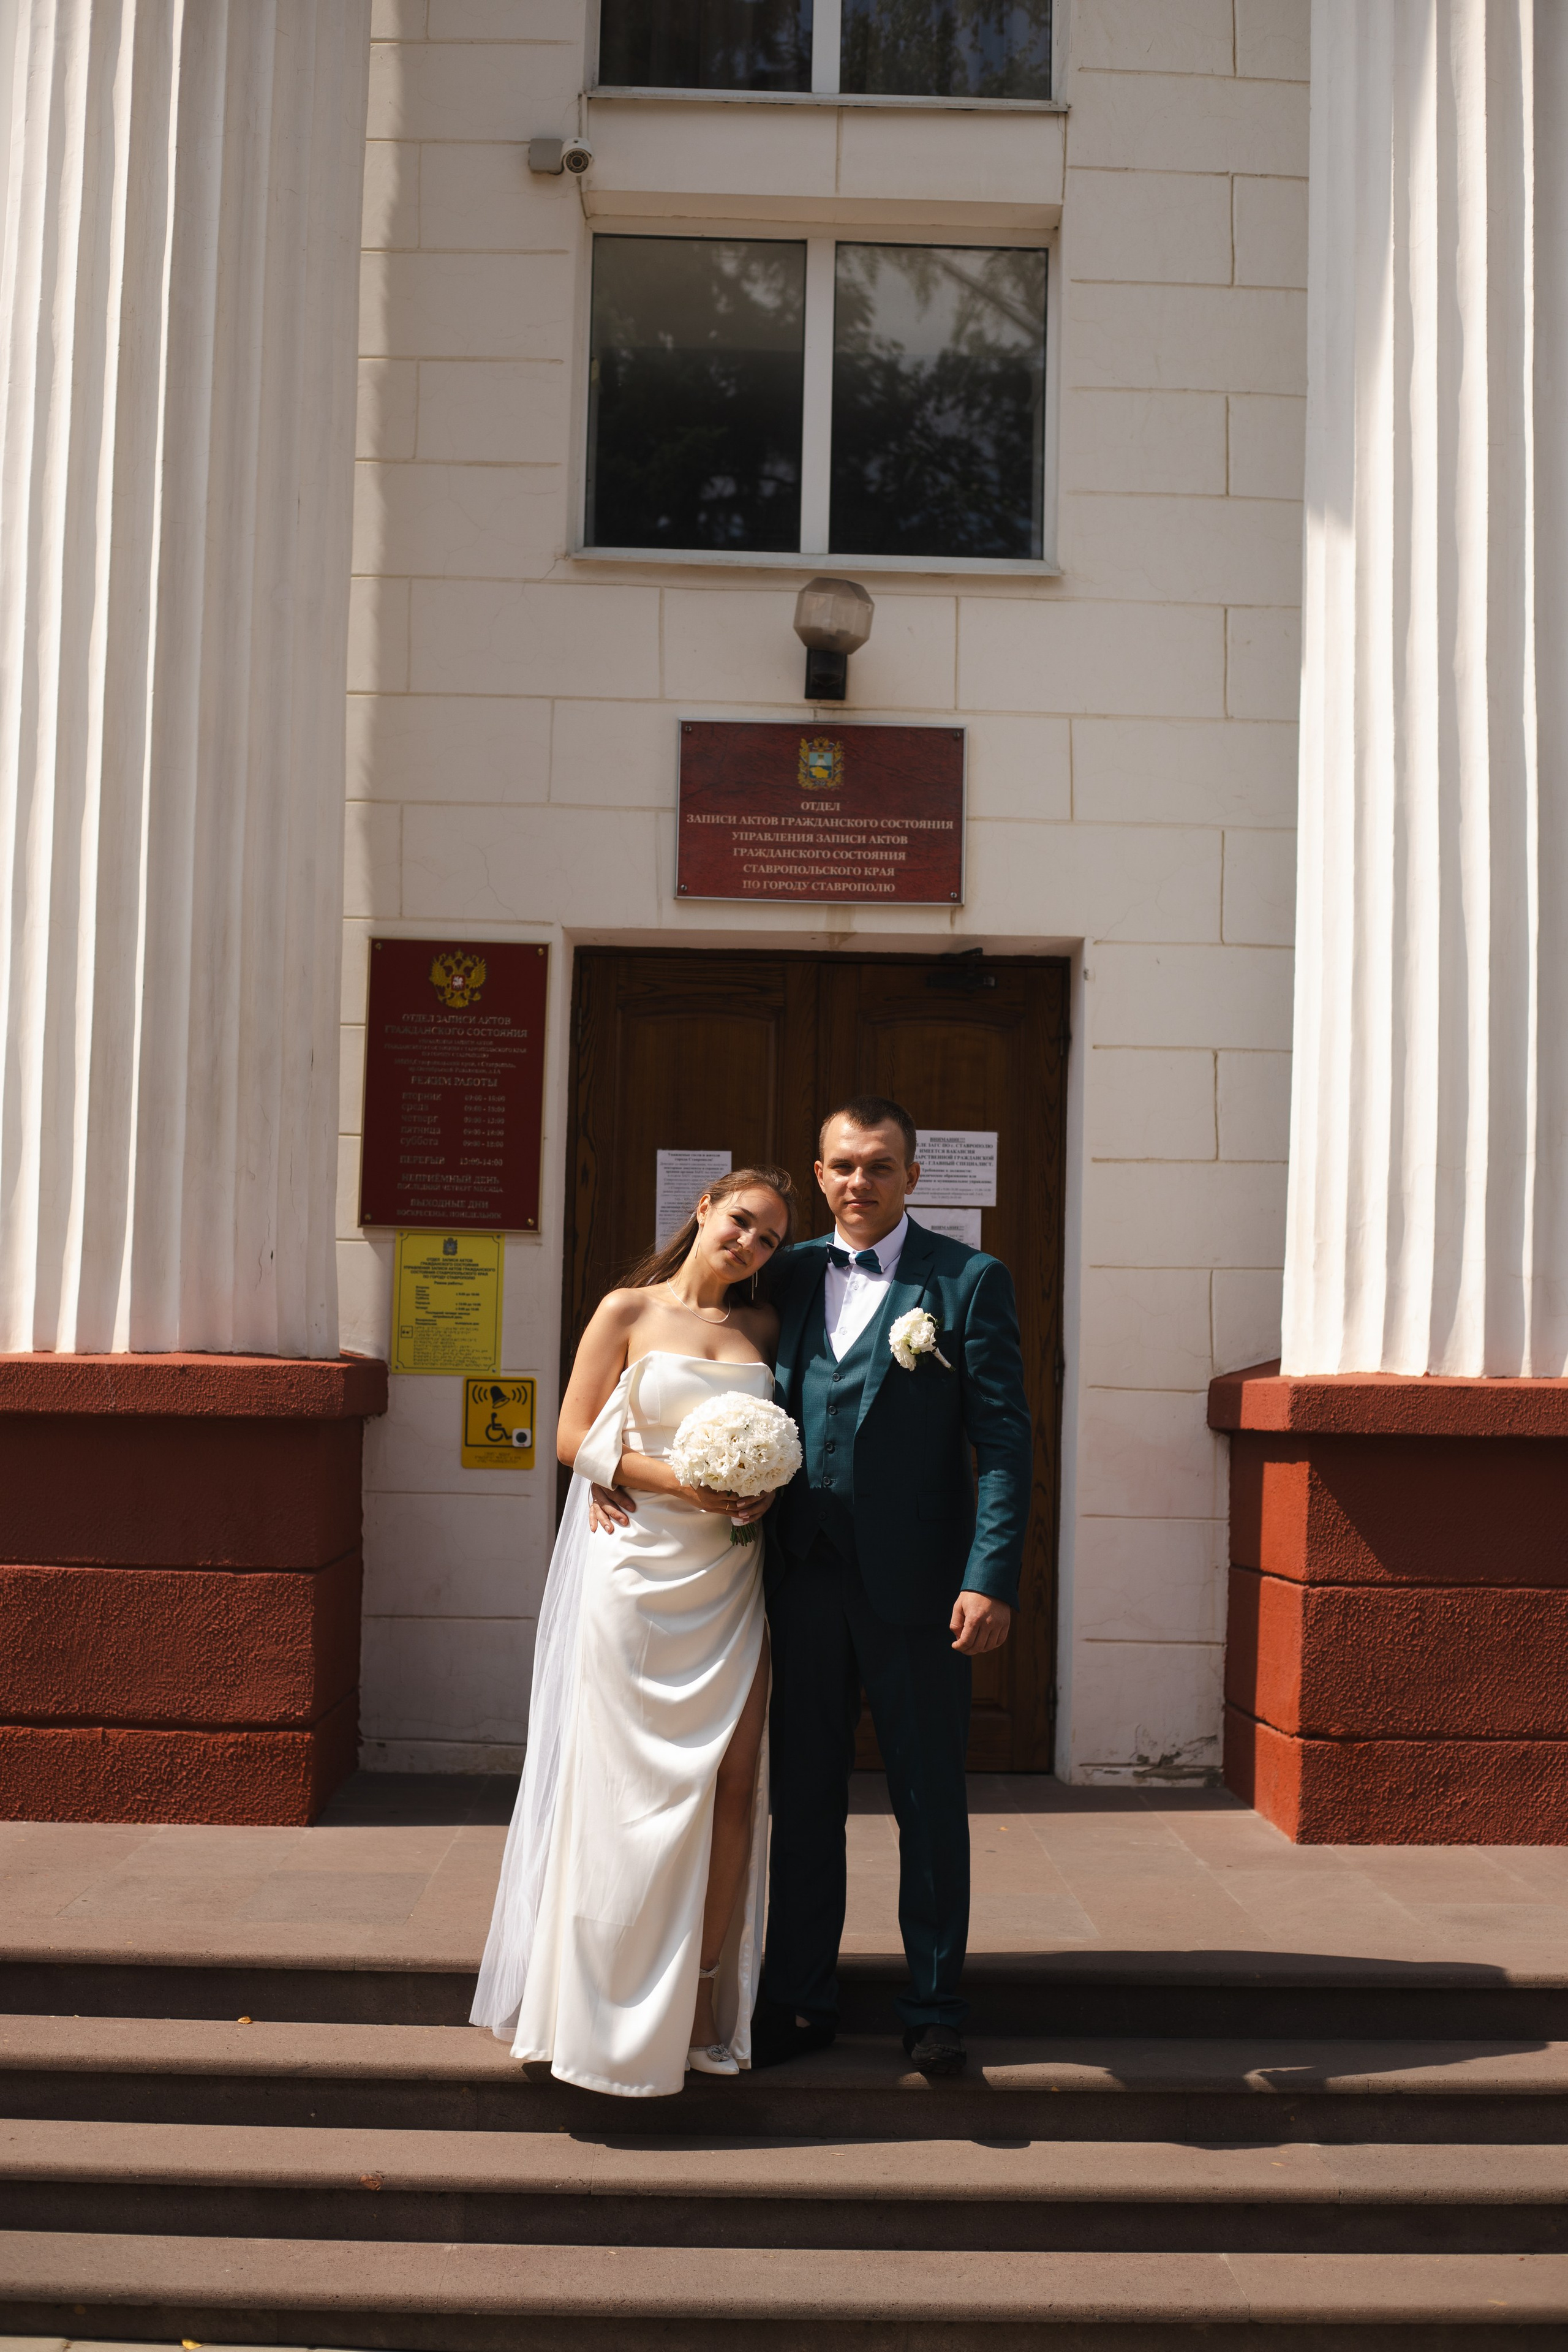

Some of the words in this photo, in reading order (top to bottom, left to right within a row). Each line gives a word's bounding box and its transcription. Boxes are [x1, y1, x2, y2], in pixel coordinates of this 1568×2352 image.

[801, 802, 840, 812] ОТДЕЛ
[687, 815, 737, 824] ЗАПИСИ
[739, 816, 778, 826] АКТОВ
[781, 818, 878, 828] ГРАЖДАНСКОГО
[880, 820, 954, 829] СОСТОЯНИЯ
[732, 832, 813, 842] УПРАВЛЕНИЯ
[816, 834, 866, 843] ЗАПИСИ
[869, 835, 908, 845] АКТОВ
[733, 848, 830, 859] ГРАЖДАНСКОГО
[833, 850, 906, 861] СОСТОЯНИЯ
[743, 864, 861, 876] СТАВРОПОЛЬСКОГО
[864, 867, 895, 876] КРАЯ
[742, 880, 760, 889] ПО
[763, 881, 809, 891] ГОРОДУ
[812, 882, 895, 892] СТАВРОПОЛЮ
[402, 1014, 434, 1023] ОТДЕЛ
[437, 1015, 476, 1025] ЗАПИСИ
[478, 1016, 511, 1025] АКТОВ
[385, 1025, 464, 1036] ГРАЖДАНСКОГО
[467, 1028, 527, 1038] СОСТОЯНИЯ
[412, 1076, 451, 1085] РЕЖИМ
[454, 1077, 497, 1087] РАБОТЫ
[400, 1155, 445, 1164] ПЕРЕРЫВ
